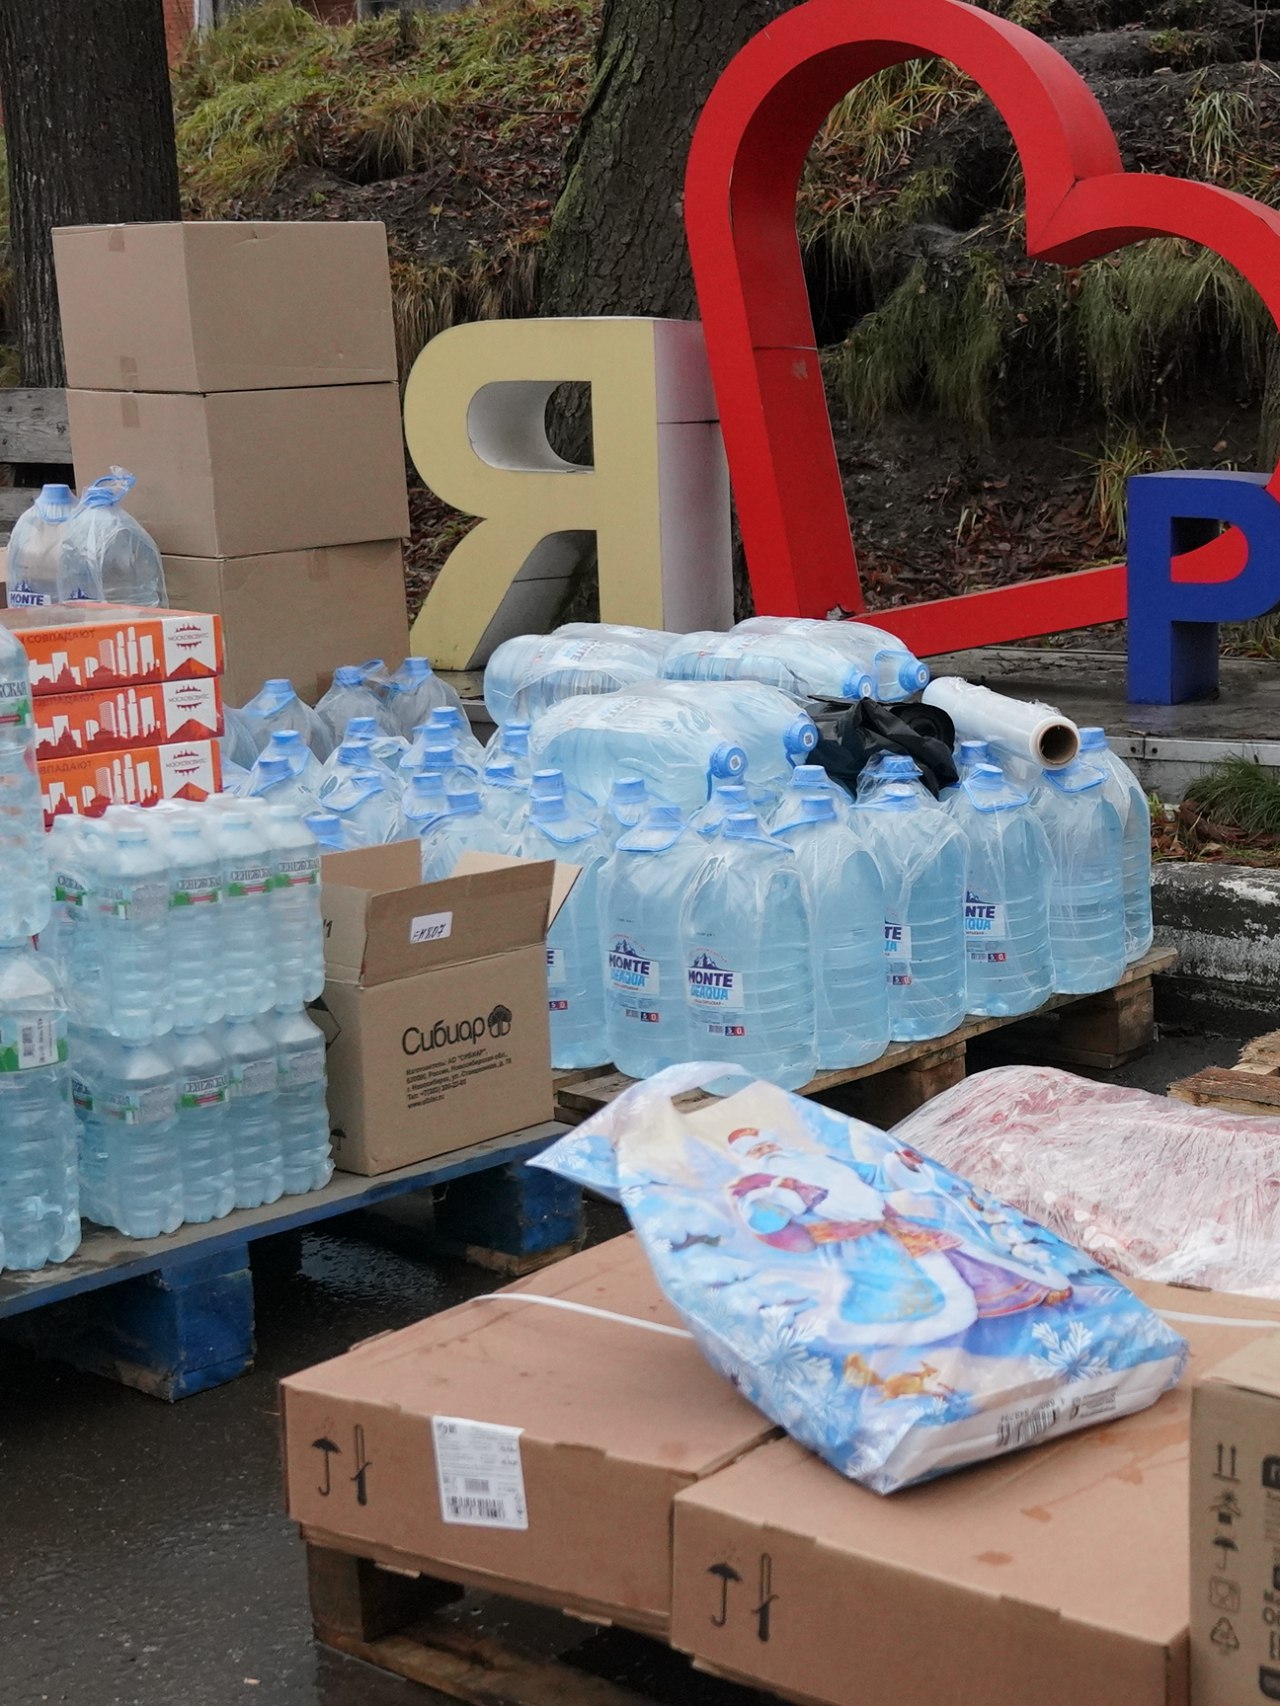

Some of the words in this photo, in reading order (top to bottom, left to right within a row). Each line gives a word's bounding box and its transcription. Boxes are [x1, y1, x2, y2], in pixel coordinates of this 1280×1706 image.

[404, 317, 668, 671] Я
[10, 592, 44, 606] MONTE
[28, 629, 96, 644] СОВПАДАЮТ
[608, 954, 650, 976] MONTE
[688, 969, 733, 988] MONTE
[402, 1016, 485, 1056] Сибиар
